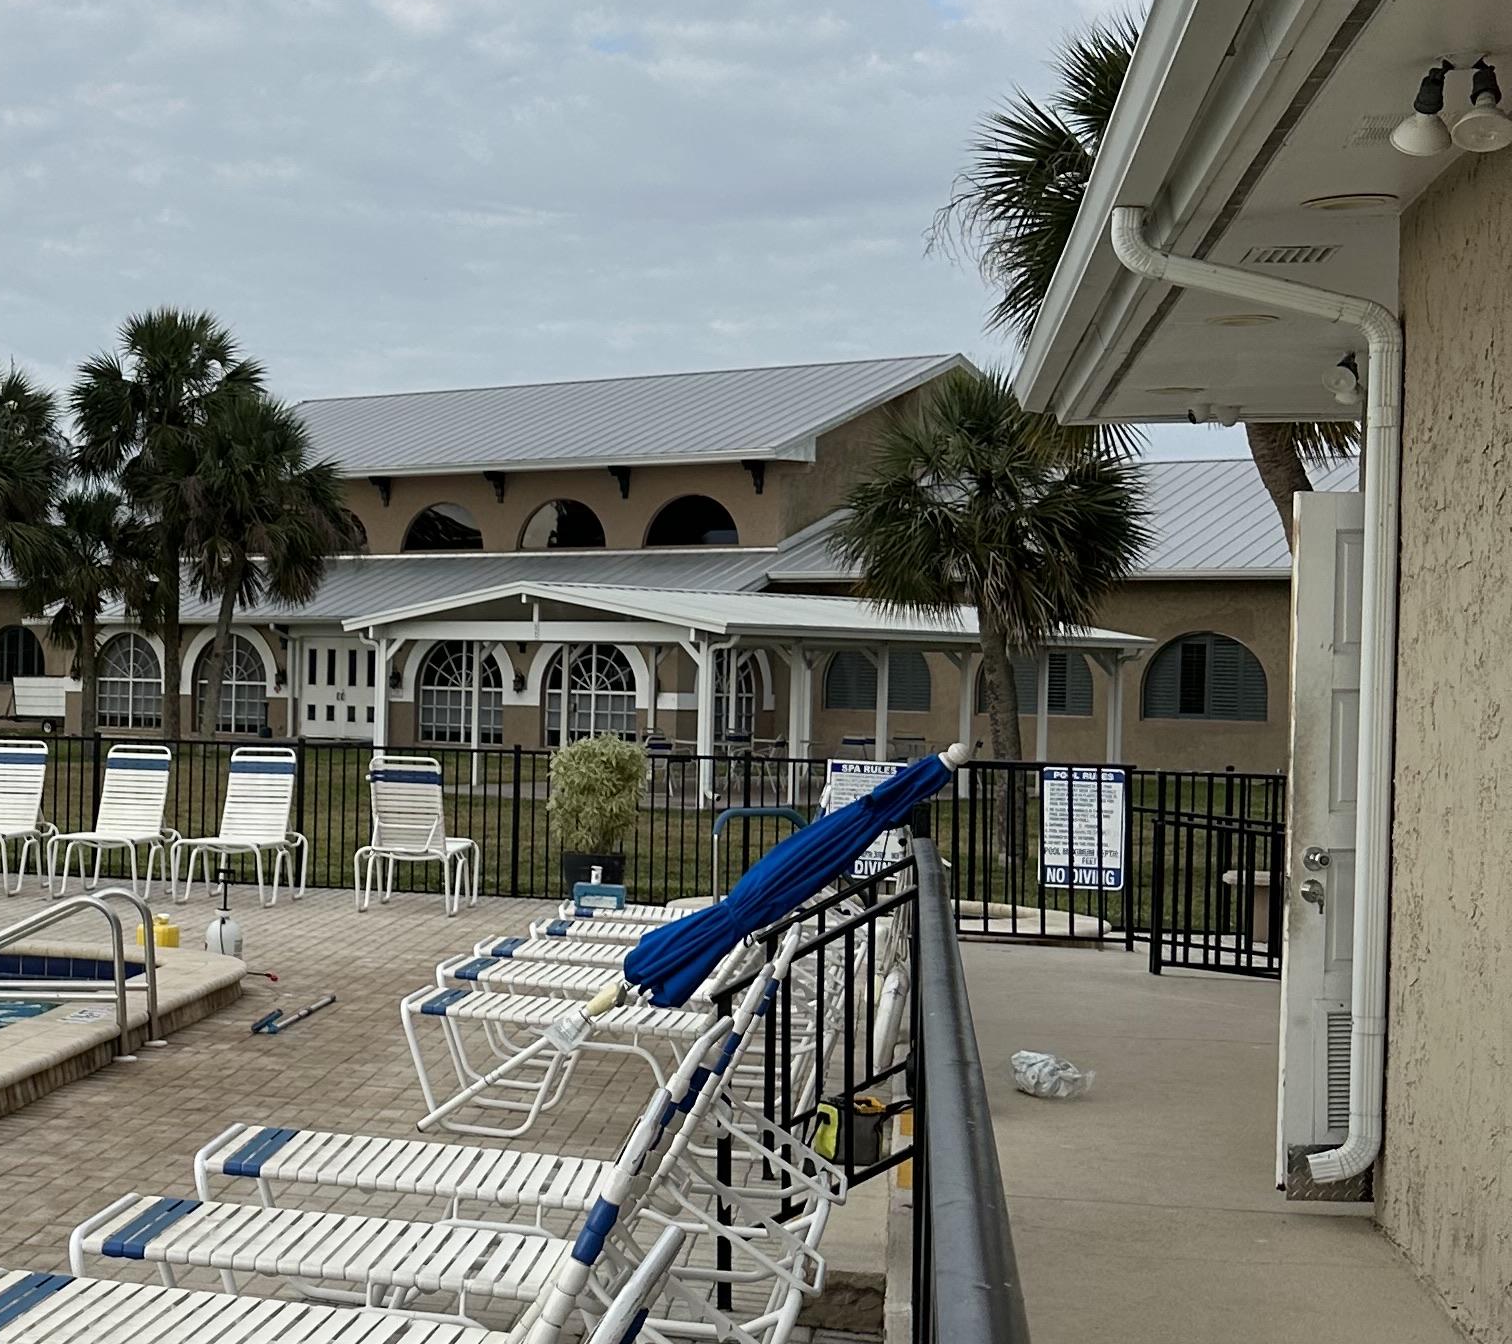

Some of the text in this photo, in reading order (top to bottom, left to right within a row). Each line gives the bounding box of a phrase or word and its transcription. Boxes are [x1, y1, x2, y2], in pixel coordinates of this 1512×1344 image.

[841, 764, 897, 775] SPA RULES
[1053, 771, 1115, 781] POL RUES
[1046, 867, 1066, 884] NO
